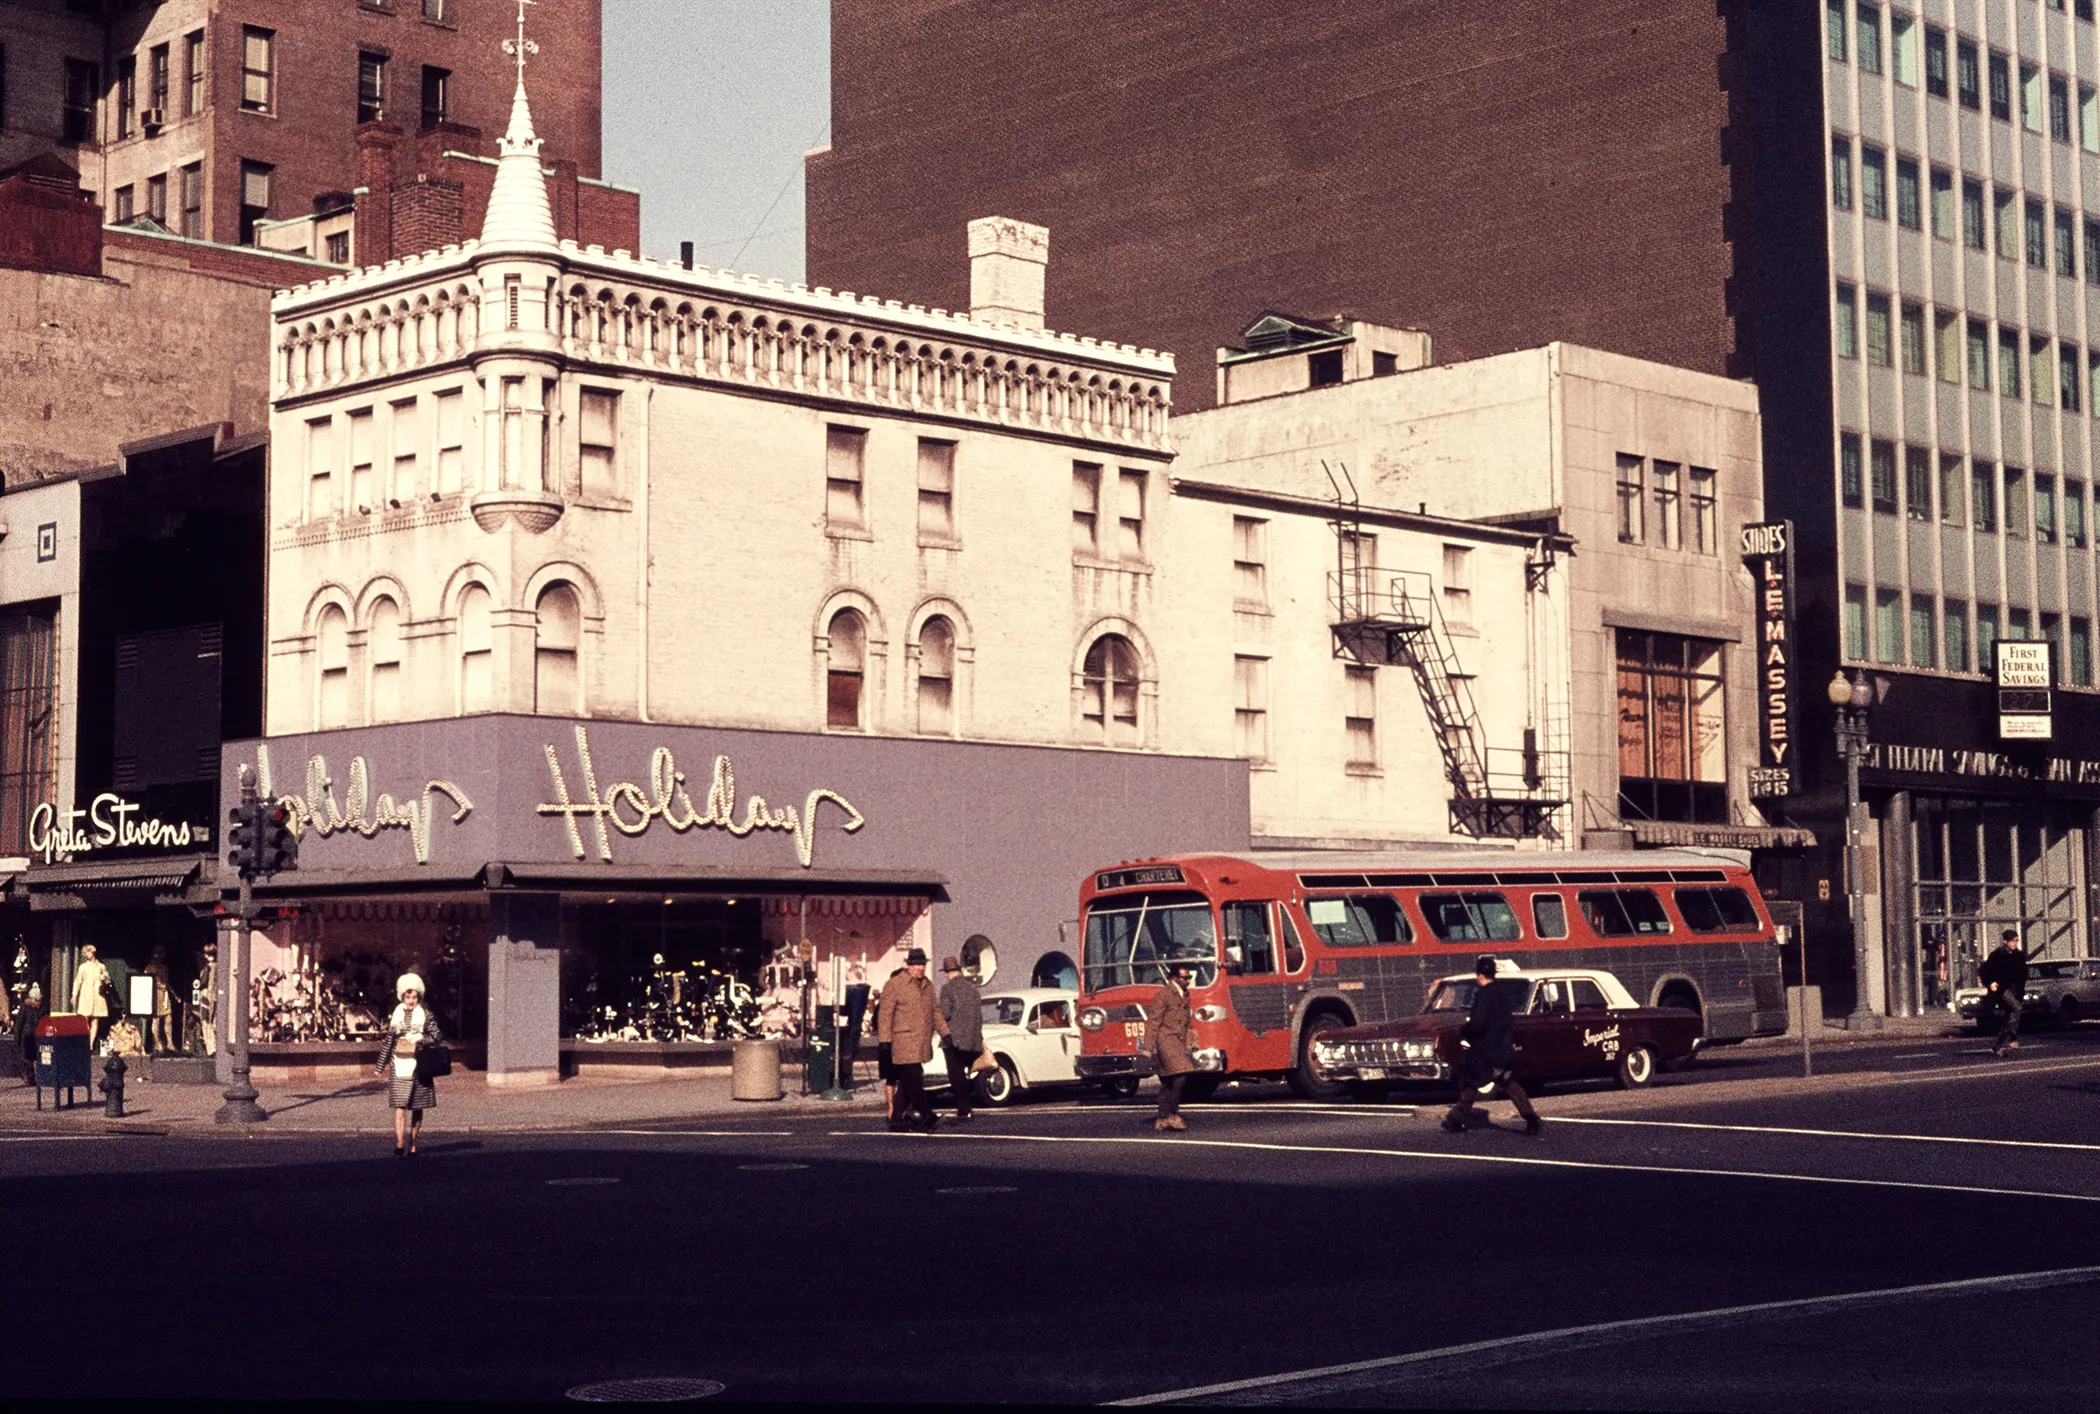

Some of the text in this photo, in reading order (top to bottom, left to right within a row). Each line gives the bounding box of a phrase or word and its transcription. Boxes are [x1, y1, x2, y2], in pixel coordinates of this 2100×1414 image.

[1742, 525, 1785, 555] SHOES
[2010, 646, 2038, 658] FIRST
[2002, 659, 2047, 671] FEDERAL
[2002, 672, 2046, 684] SAVINGS
[1750, 768, 1790, 782] SIZES
[1774, 780, 1788, 795] 15
[237, 743, 474, 865] oliday
[536, 725, 865, 868] Holiday
[29, 793, 190, 864] Greta Stevens
[1125, 1022, 1146, 1037] 609
[1582, 1024, 1620, 1047] Imperial
[1602, 1040, 1620, 1052] CAB
